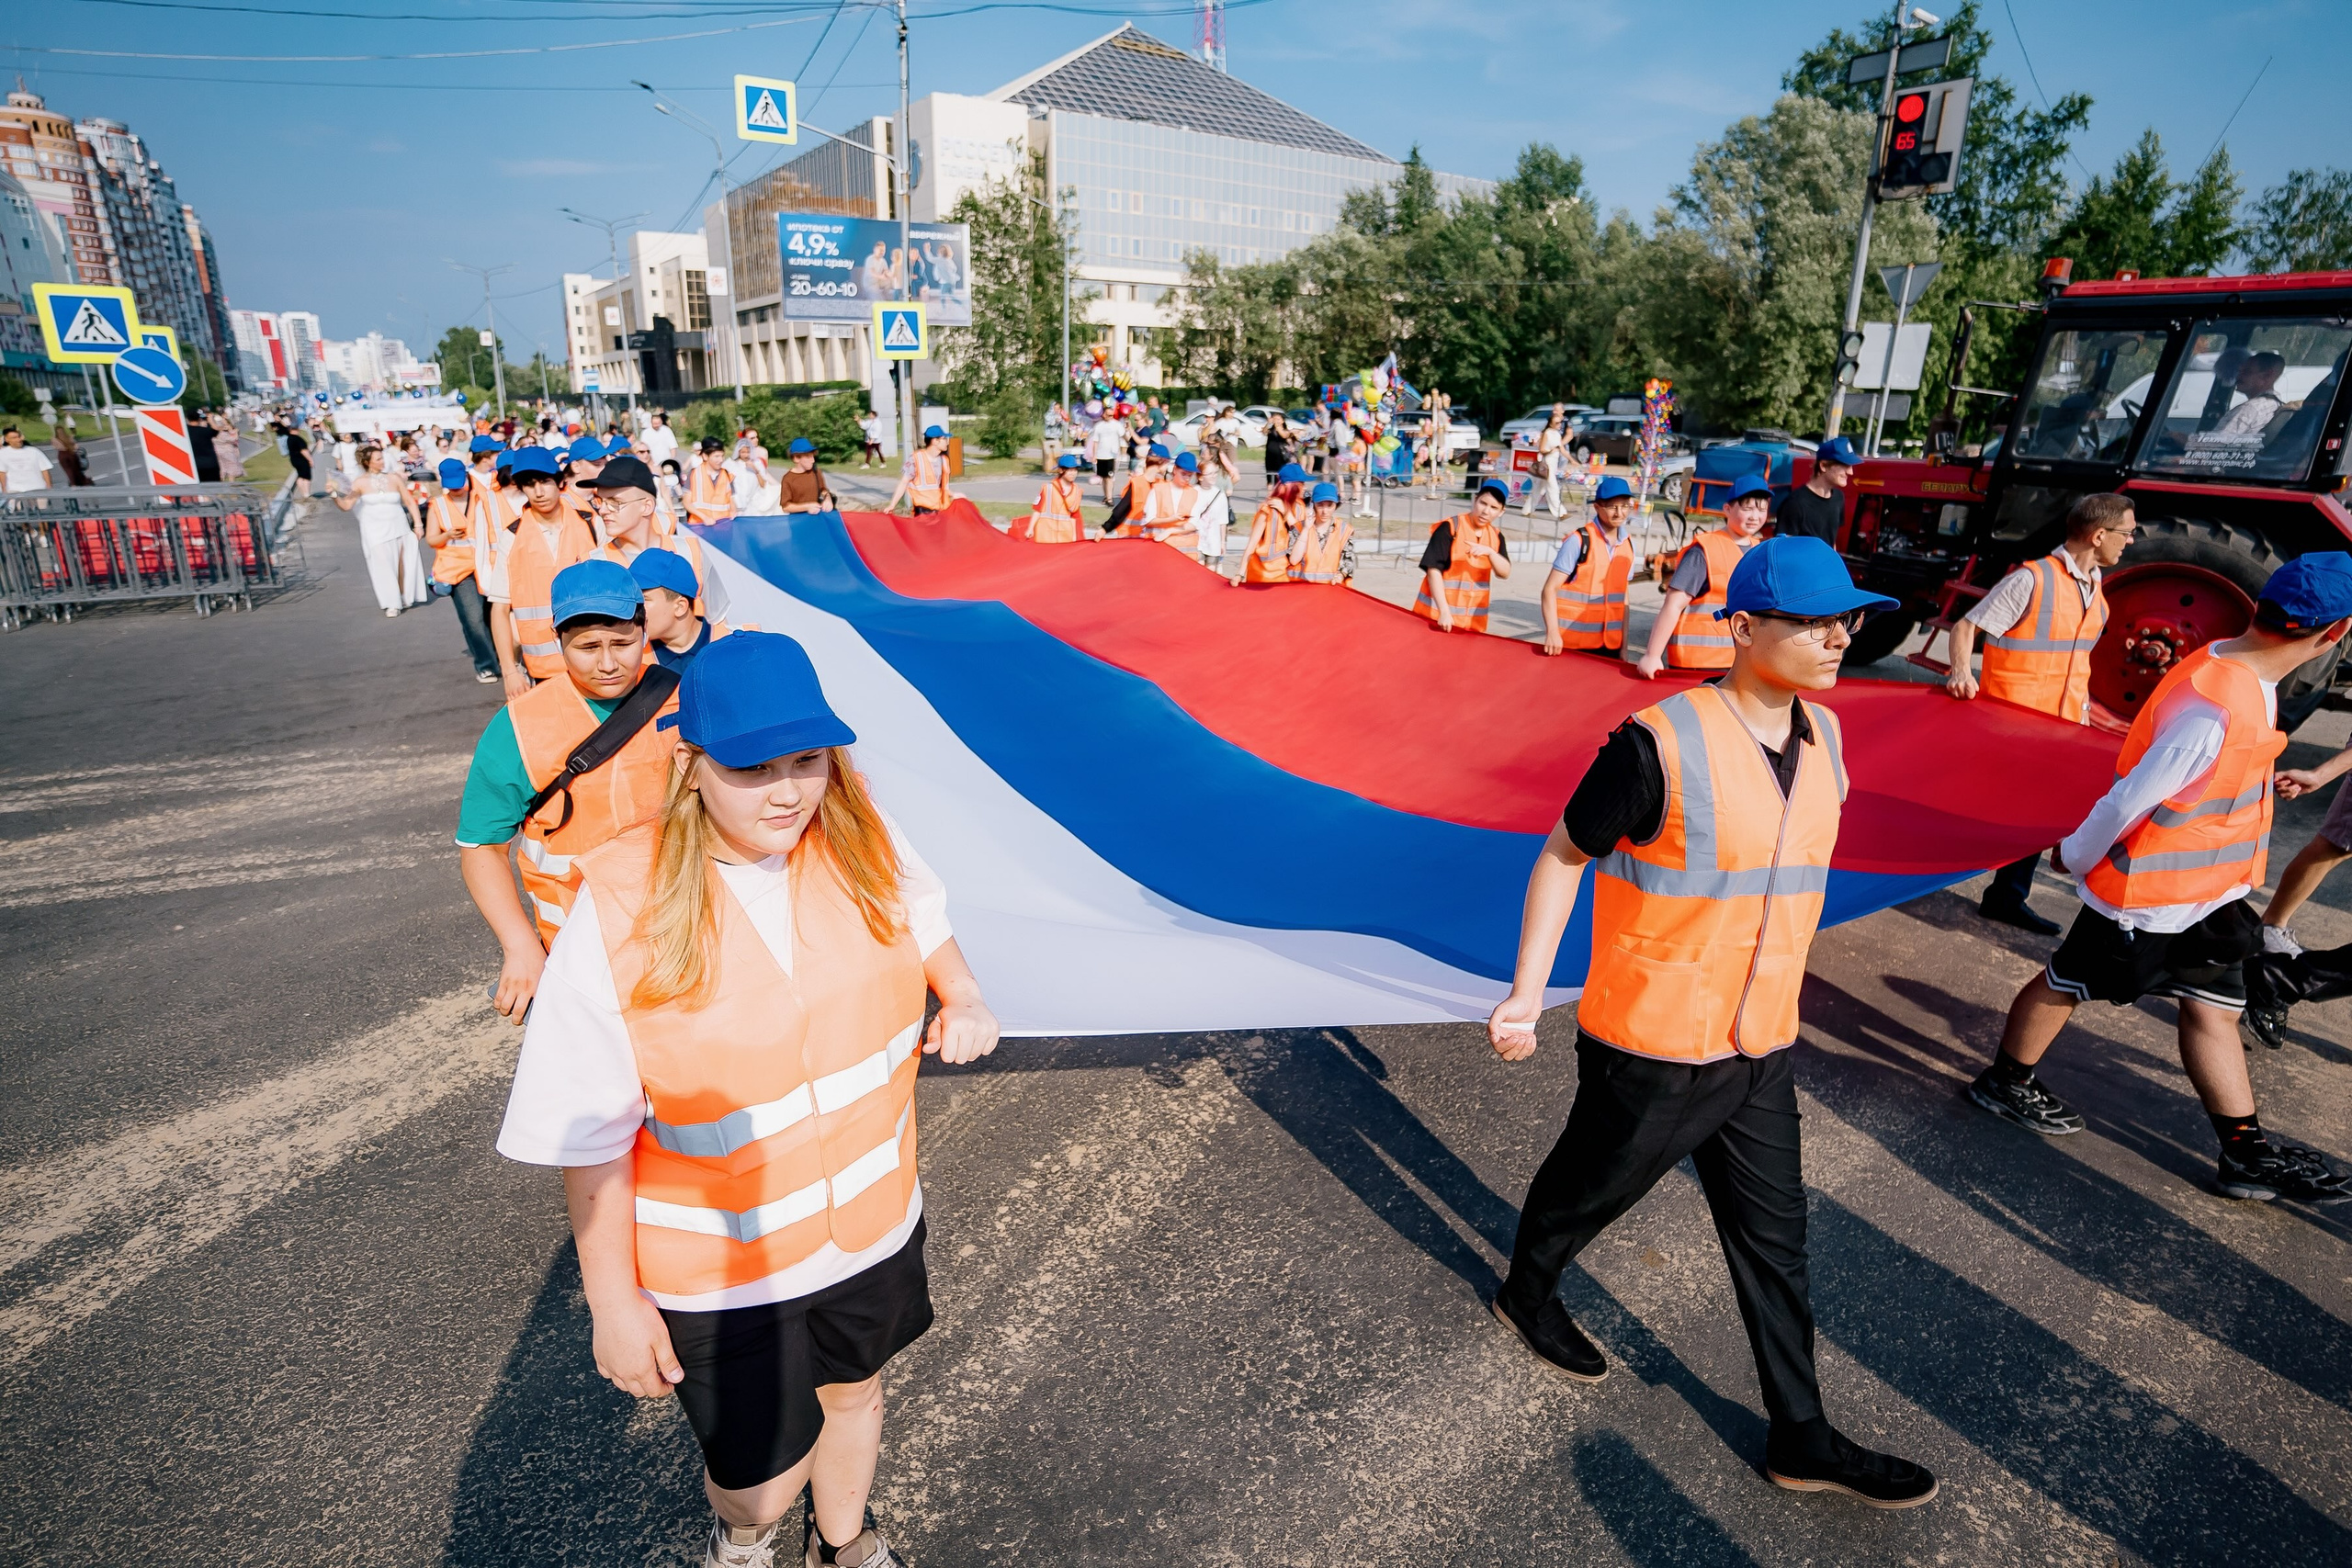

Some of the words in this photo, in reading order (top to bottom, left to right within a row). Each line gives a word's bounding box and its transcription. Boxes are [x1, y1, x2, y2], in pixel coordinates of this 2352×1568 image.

[1895, 131, 1916, 151] 65
[787, 232, 840, 256] 4,9%
[789, 280, 858, 297] 20-60-10
[2185, 451, 2192, 459] 8
[2191, 451, 2212, 460] (800)
[2212, 451, 2256, 461] 600-71-90
